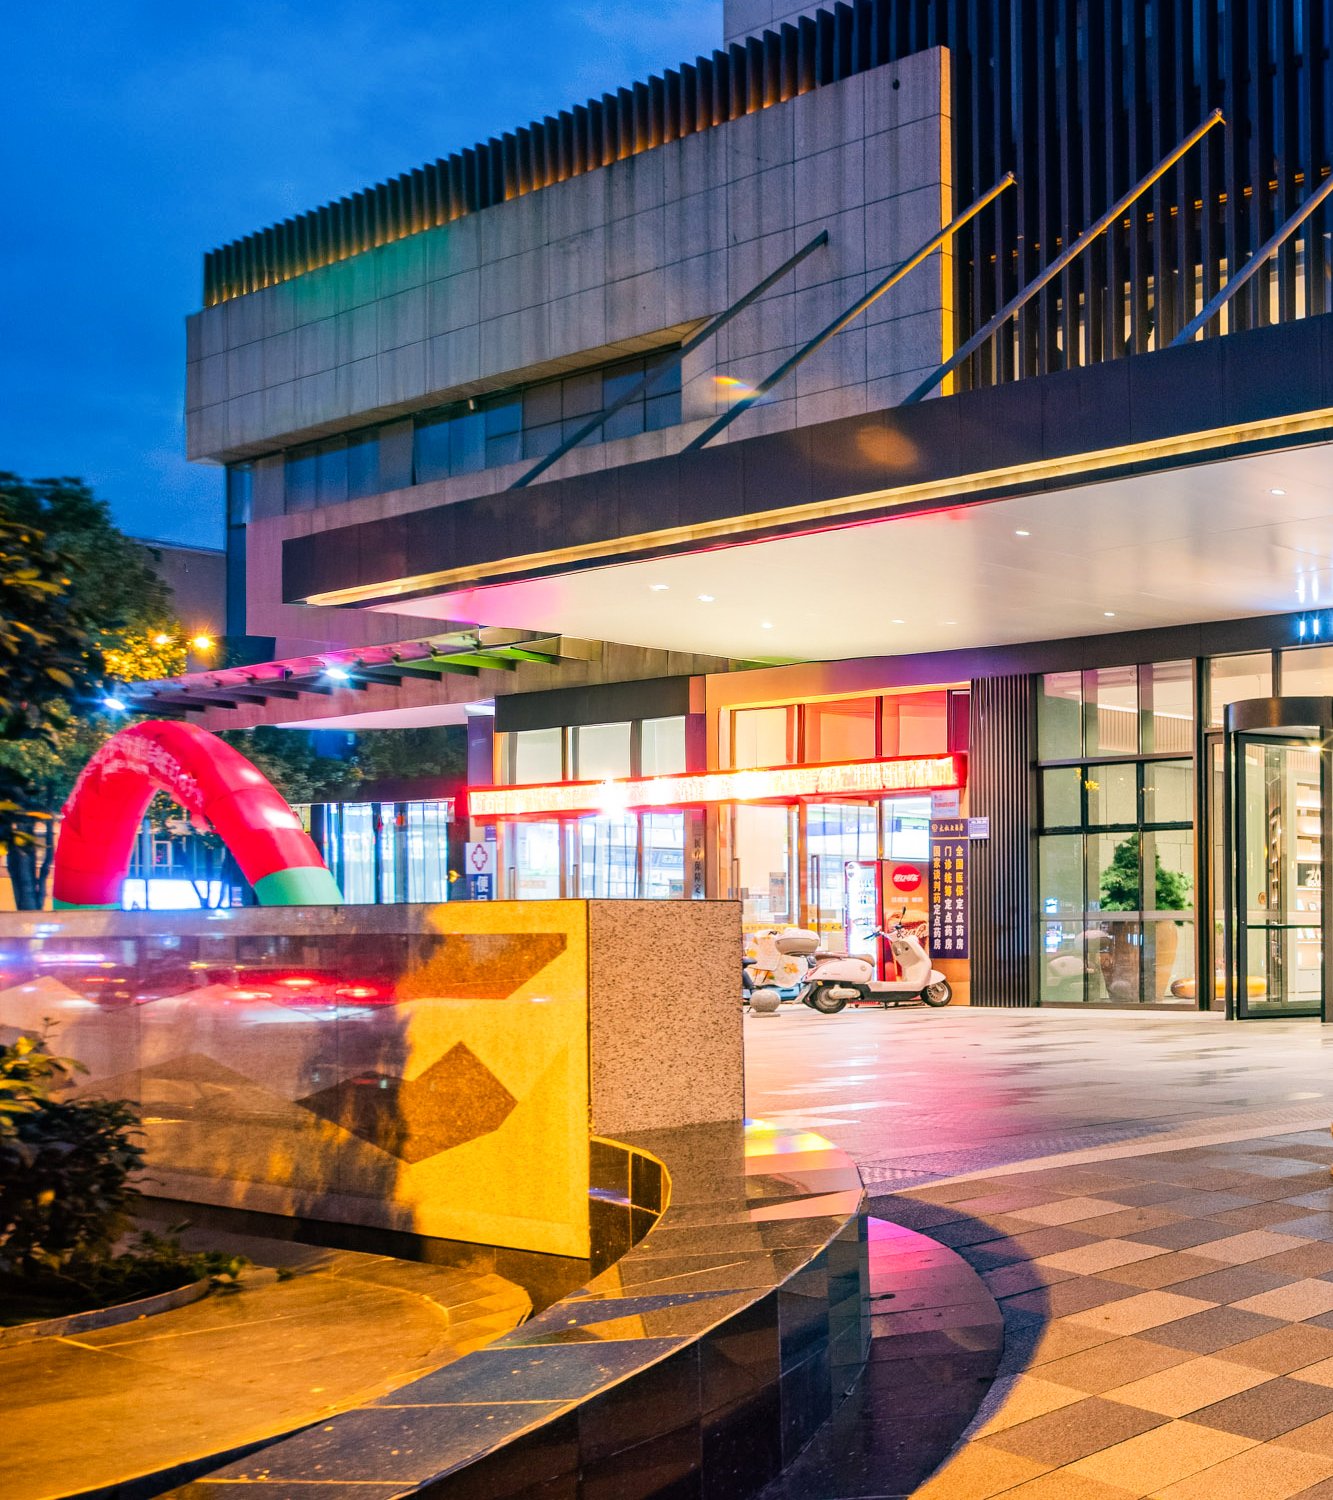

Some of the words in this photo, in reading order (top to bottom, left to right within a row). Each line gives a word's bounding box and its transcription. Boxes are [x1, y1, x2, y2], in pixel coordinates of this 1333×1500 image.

[933, 845, 942, 950] 国家谈判药定点药房
[944, 845, 953, 950] 门诊统筹定点药房
[955, 844, 964, 950] 全国医保定点药房
